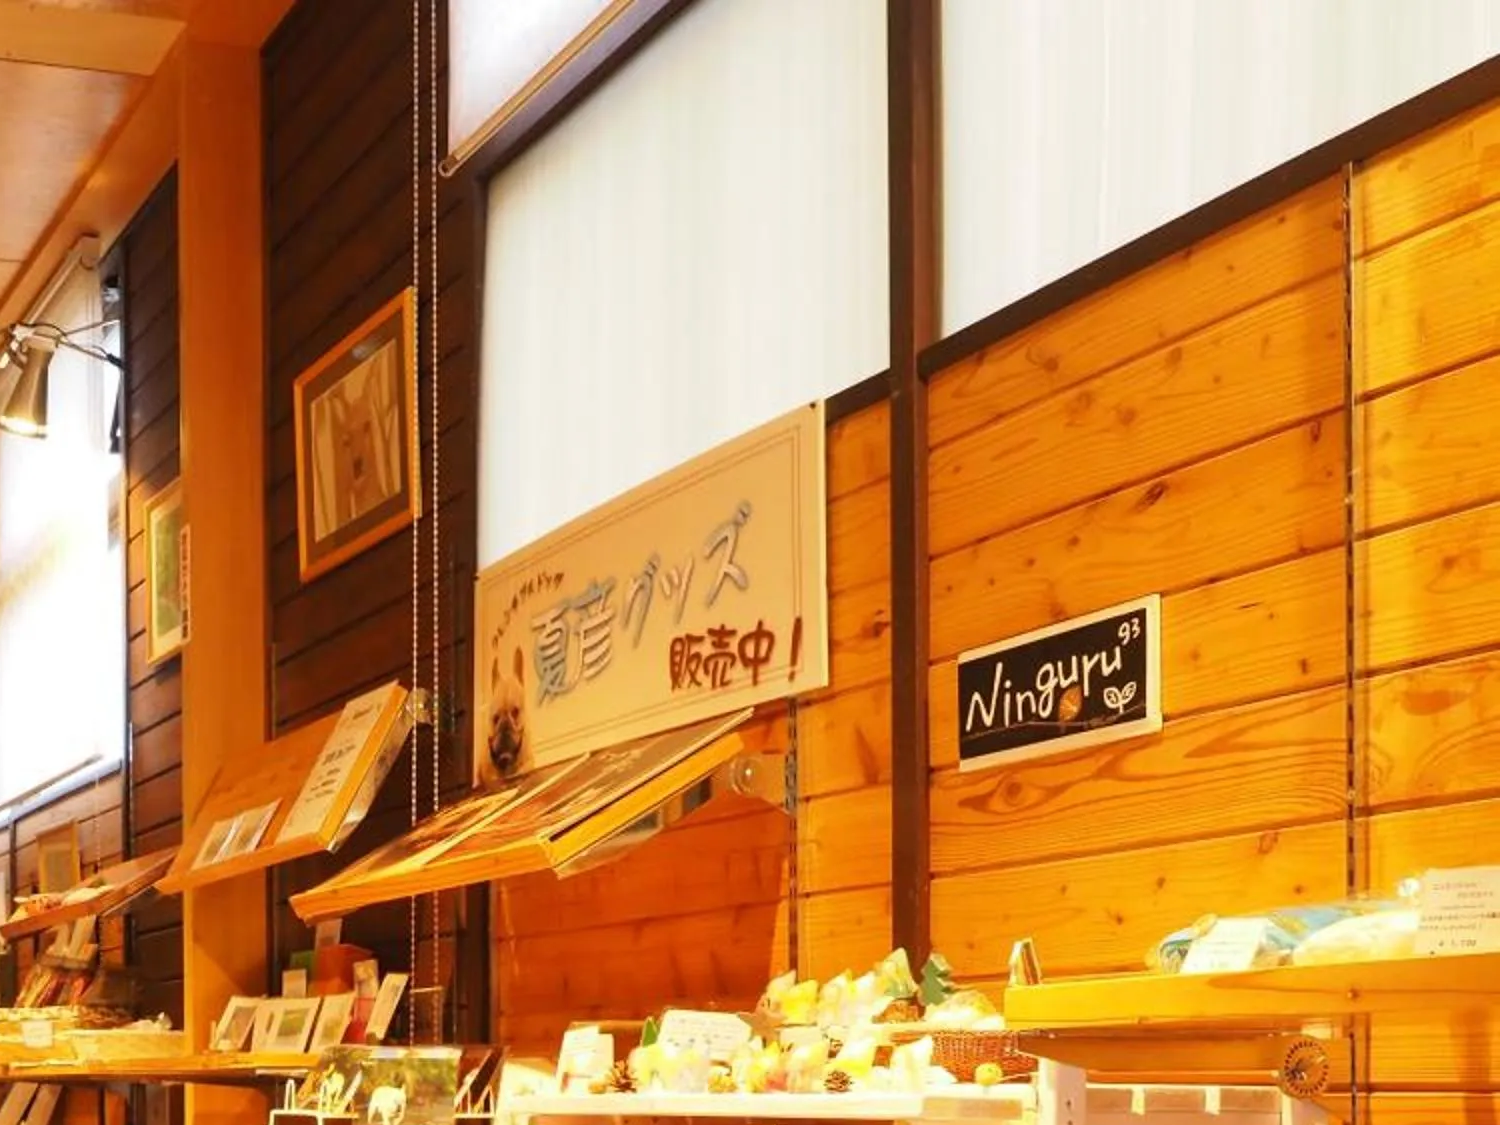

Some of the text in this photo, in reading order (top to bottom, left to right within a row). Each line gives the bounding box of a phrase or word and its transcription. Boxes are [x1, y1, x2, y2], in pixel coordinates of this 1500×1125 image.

[531, 498, 754, 706] 夏音グッズ
[964, 642, 1124, 733] Ninguru
